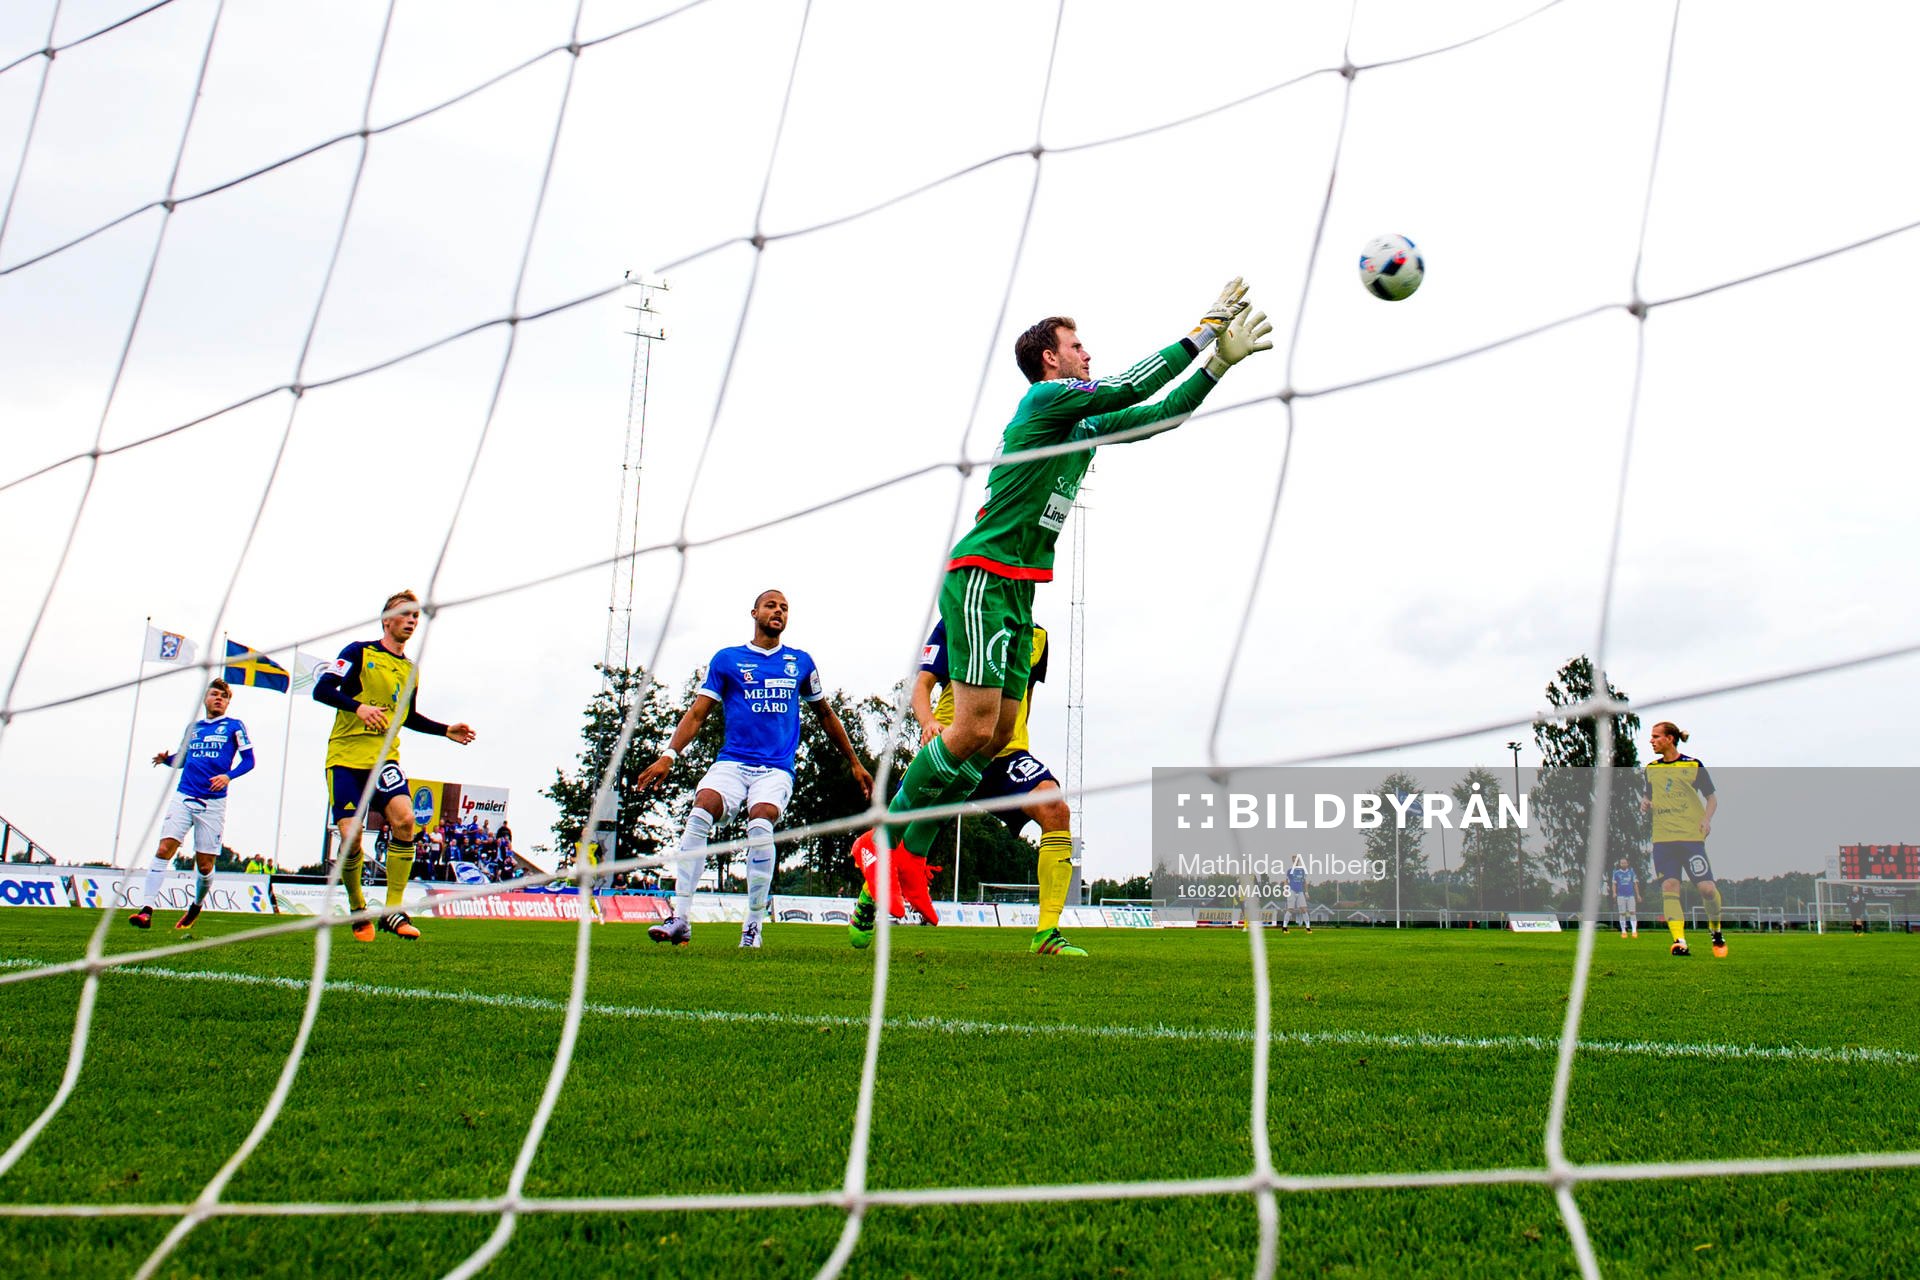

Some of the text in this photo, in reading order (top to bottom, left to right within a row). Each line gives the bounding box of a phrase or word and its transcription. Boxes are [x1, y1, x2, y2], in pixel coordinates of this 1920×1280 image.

[744, 688, 794, 700] MELLBY
[751, 700, 788, 713] GÅRD
[475, 799, 507, 813] måleri
[0, 879, 56, 905] ORT
[112, 881, 241, 910] SCNDSICK
[488, 895, 510, 917] för
[512, 896, 557, 918] svensk
[1110, 912, 1155, 928] PEAB
